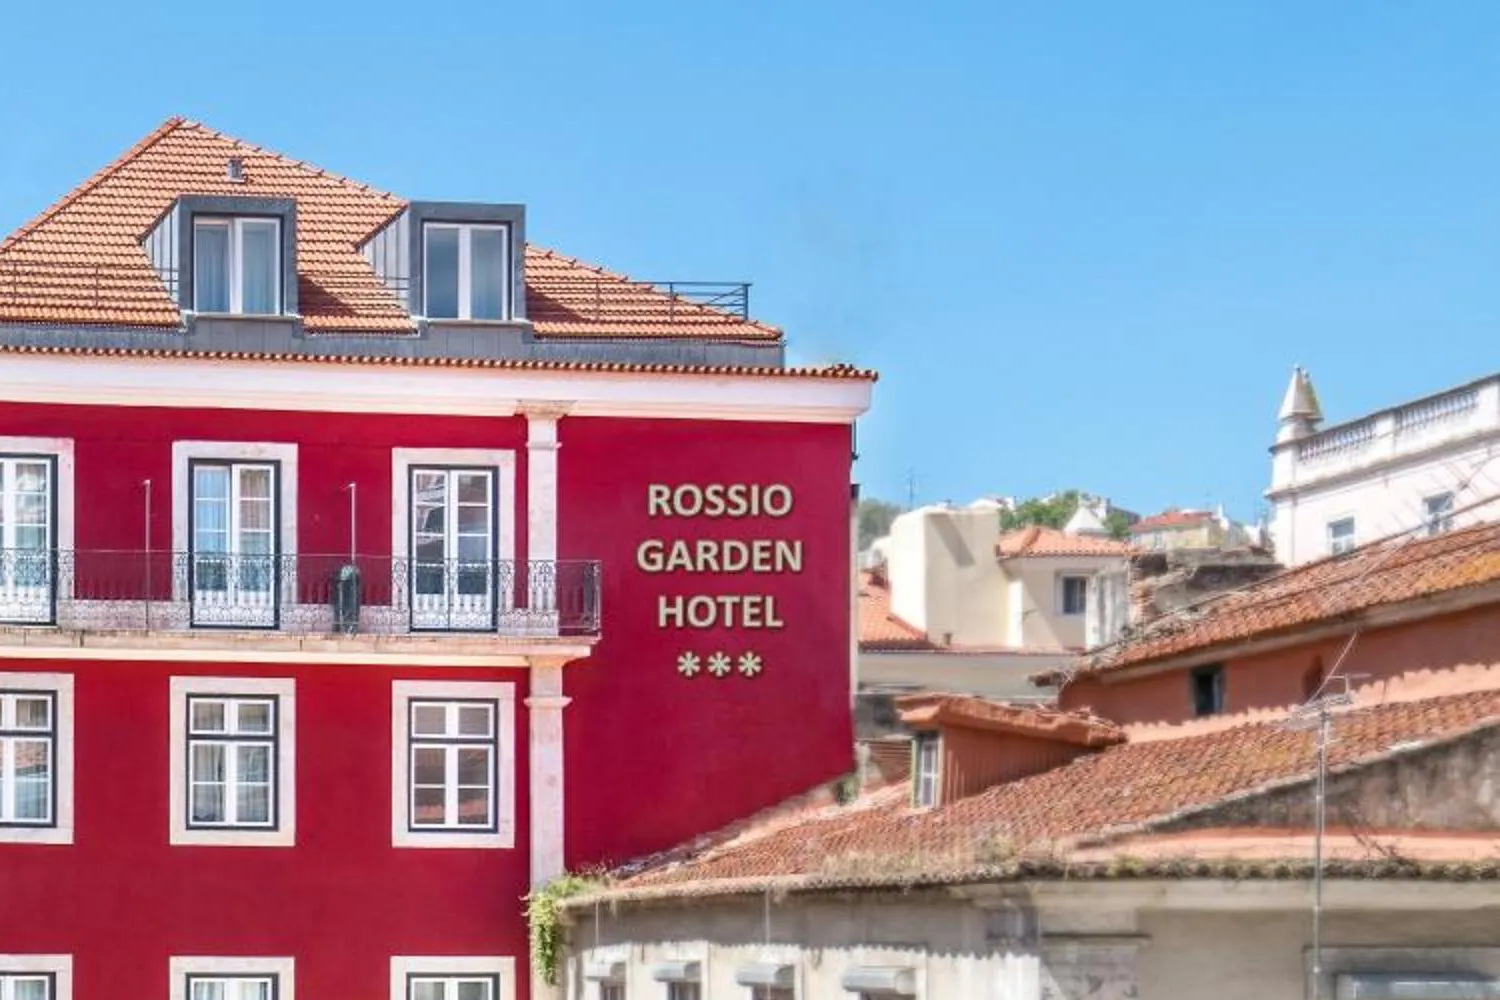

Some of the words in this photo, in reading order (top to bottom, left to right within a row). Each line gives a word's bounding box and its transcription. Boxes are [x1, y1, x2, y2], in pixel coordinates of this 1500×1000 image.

[647, 483, 793, 517] ROSSIO
[636, 539, 803, 573] GARDEN
[657, 595, 785, 628] HOTEL
